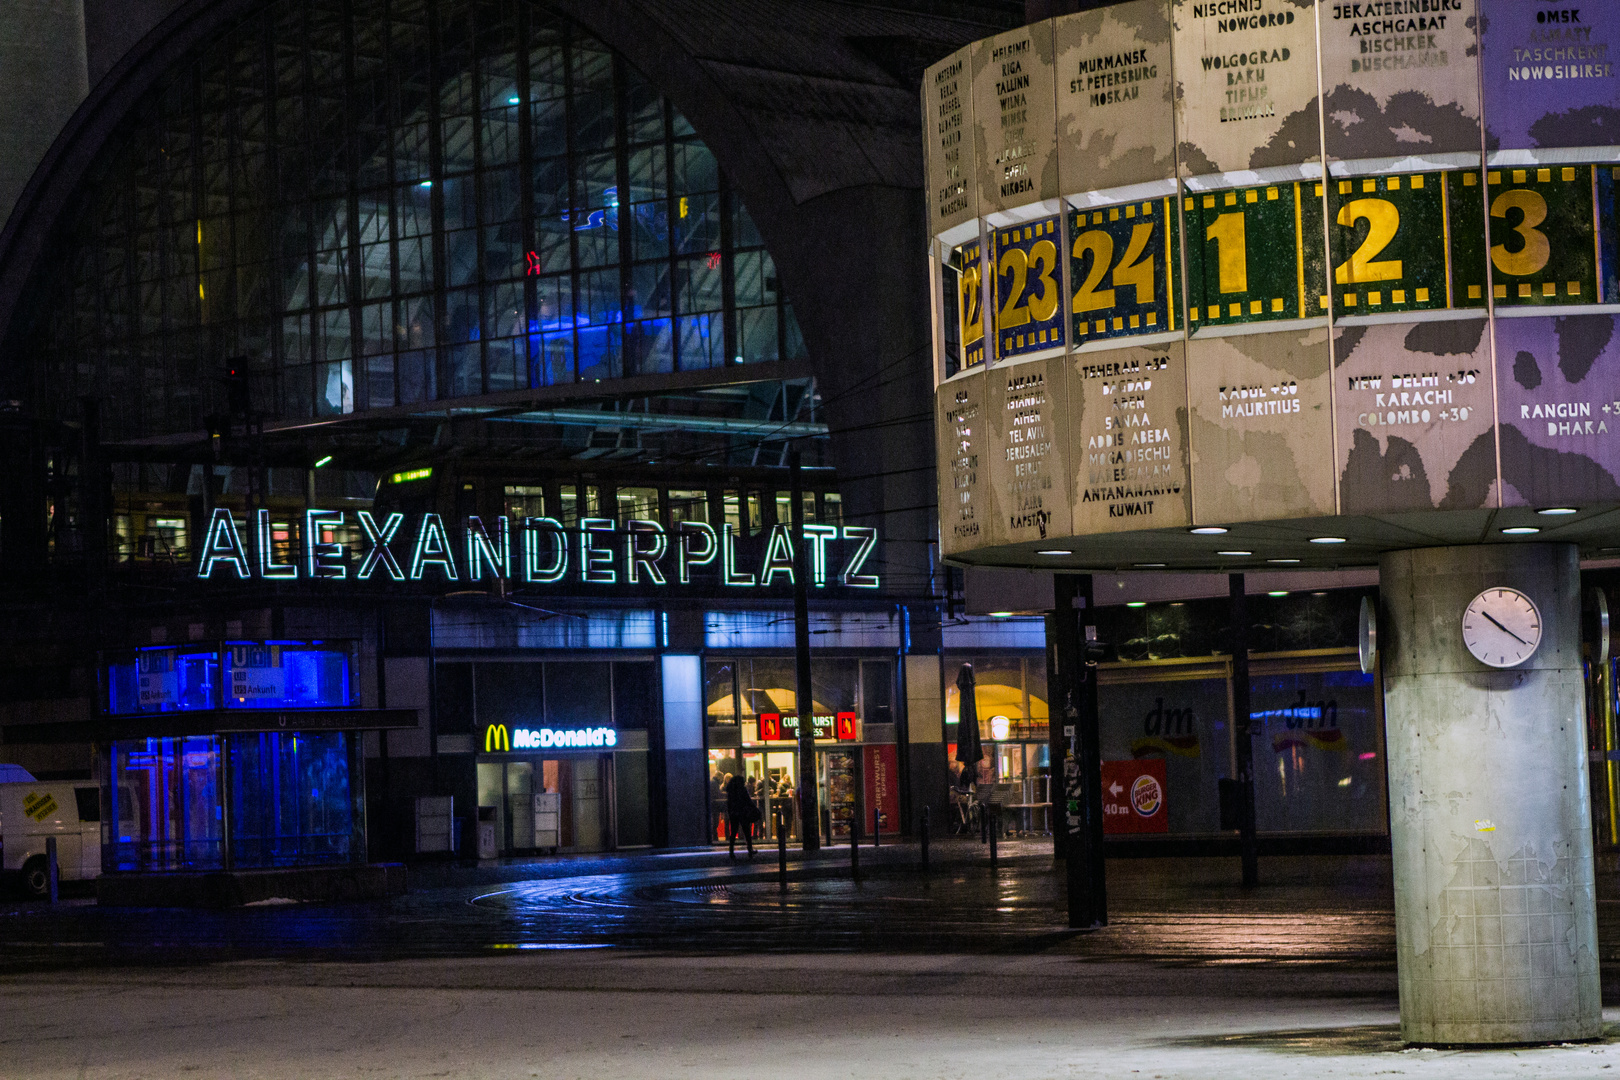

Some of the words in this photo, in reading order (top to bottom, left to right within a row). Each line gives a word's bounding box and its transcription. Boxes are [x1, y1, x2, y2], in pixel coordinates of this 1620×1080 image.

[1193, 0, 1262, 18] NISCHNIJ
[1333, 0, 1461, 19] JEKATERINBURG
[1537, 9, 1580, 24] OMSK
[1218, 11, 1294, 33] NOWGOROD
[1350, 16, 1446, 37] ASCHGABAT
[1360, 34, 1438, 53] BISCHKEK
[1530, 26, 1592, 43] ALMATY
[1079, 49, 1147, 74] MURMANSK
[1201, 47, 1290, 72] WOLGOGRAD
[1351, 50, 1449, 73] DUSCHANBE
[1513, 43, 1608, 62] TASCHKENT
[1002, 60, 1021, 77] RIGA
[1227, 69, 1265, 86] BAKU
[1509, 62, 1614, 80] NOWOSIBIRSK
[996, 74, 1029, 96] TALLINN
[1070, 79, 1084, 93] ST.
[1087, 65, 1157, 90] PETERSBURG
[1000, 93, 1027, 111] WILNA
[1090, 86, 1139, 107] MOSKAU
[1001, 109, 1027, 128] MINSK
[1001, 178, 1034, 197] NIKOSIA
[1336, 198, 1403, 284] 2
[1490, 189, 1551, 276] 3
[1207, 212, 1248, 294] 1
[1073, 222, 1155, 314] 24
[1000, 240, 1059, 330] 23
[1083, 361, 1140, 379] TEHERAN
[1007, 374, 1044, 392] ANKARA
[1348, 375, 1382, 391] NEW
[1392, 372, 1439, 389] DELHI
[1219, 385, 1266, 401] KABUL
[1376, 390, 1453, 408] KARACHI
[1222, 399, 1300, 419] MAURITIUS
[1358, 409, 1431, 427] COLOMBO
[1521, 402, 1591, 419] RANGUN
[1105, 413, 1151, 430] SANAA
[1548, 420, 1608, 437] DHAKA
[1009, 430, 1024, 443] TEL
[1027, 425, 1045, 441] AVIV
[1088, 432, 1124, 450] ADDIS
[1131, 428, 1171, 446] ABEBA
[1005, 442, 1052, 461] JERUSALEM
[1089, 446, 1171, 467] MOGADISCHU
[1015, 461, 1041, 477] BEIRUT
[1083, 481, 1180, 502] ANTANANARIVO
[1109, 501, 1154, 518] KUWAIT
[198, 507, 879, 589] ALEXANDERPLATZ
[1144, 698, 1193, 736] dm
[513, 727, 617, 748] McDonald's
[1134, 782, 1157, 798] BURGER
[1136, 789, 1159, 807] KING
[1104, 803, 1118, 815] 40
[1119, 805, 1129, 815] m
